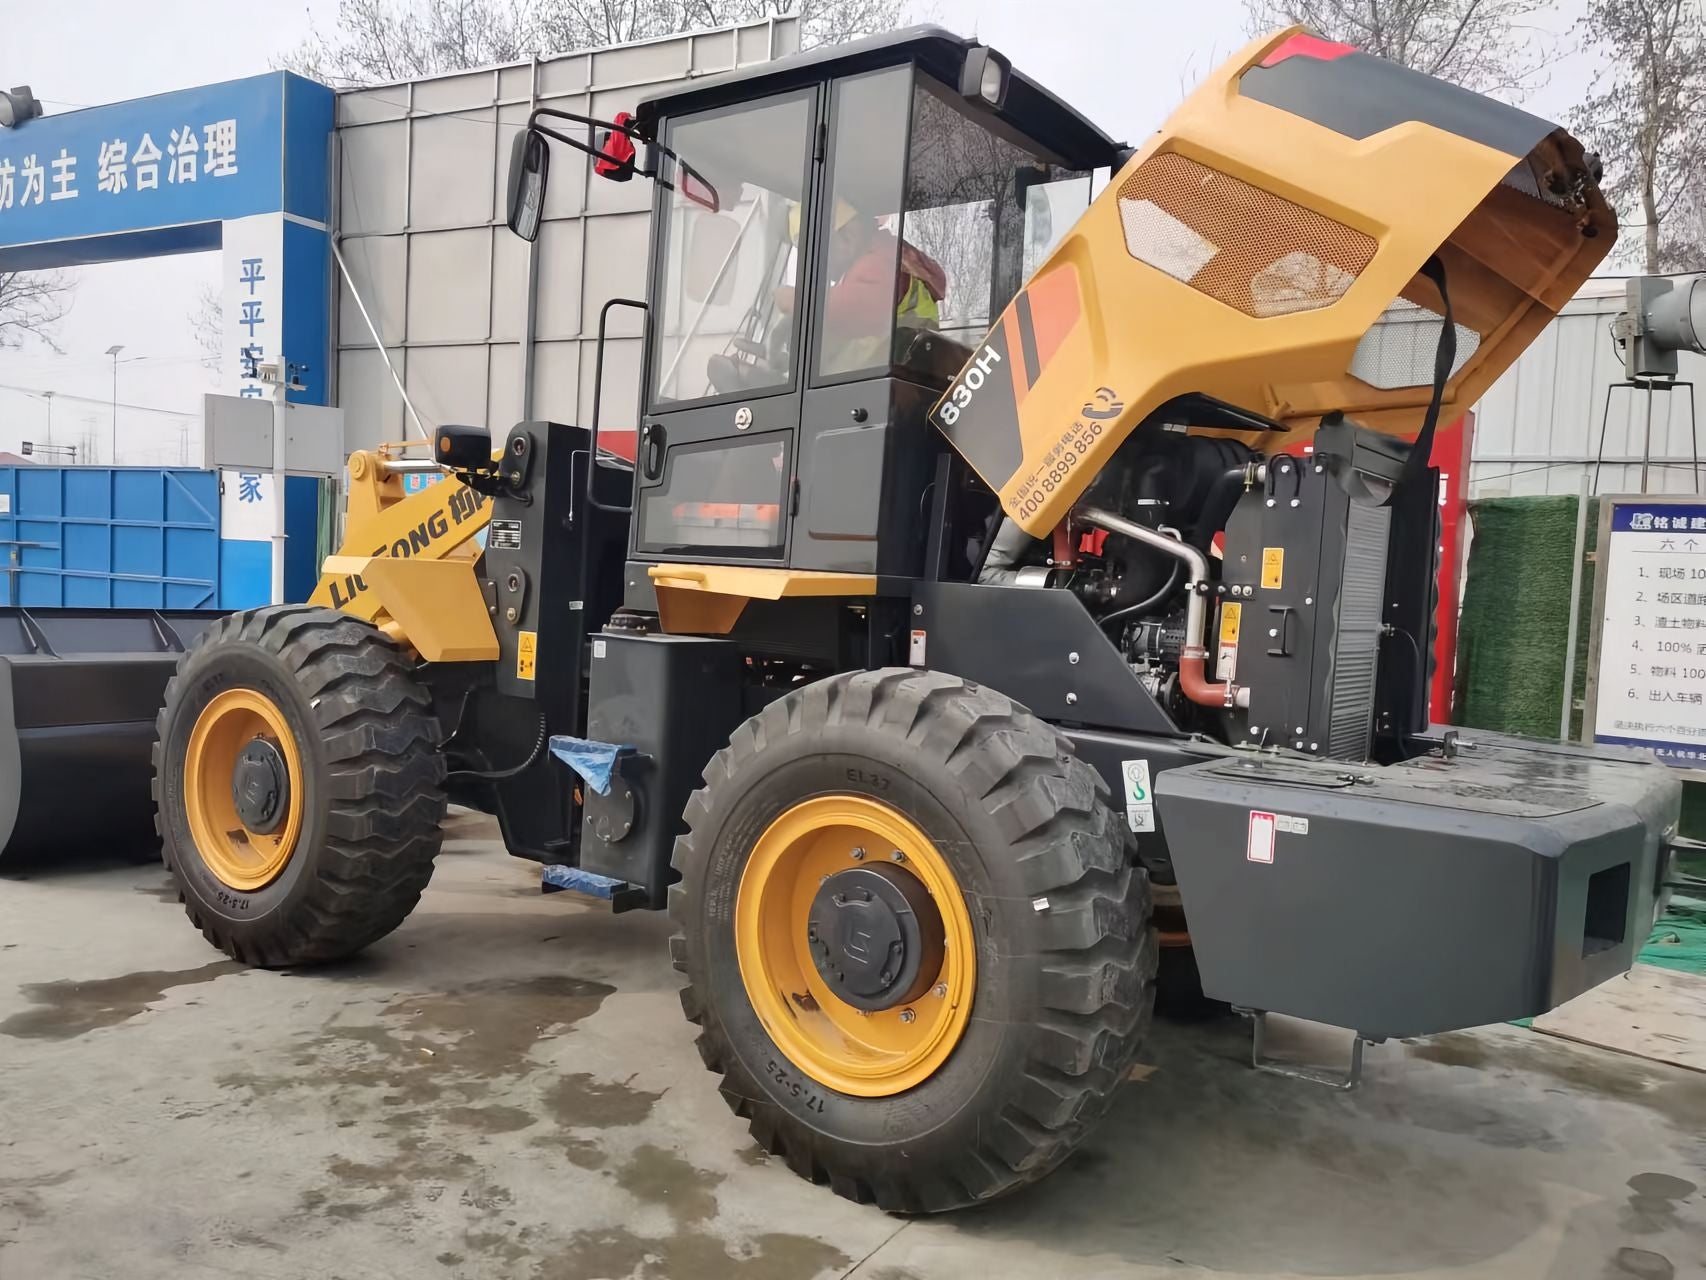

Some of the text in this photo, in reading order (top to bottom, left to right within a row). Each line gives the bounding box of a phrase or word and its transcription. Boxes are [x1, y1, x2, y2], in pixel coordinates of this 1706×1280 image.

[97, 118, 238, 194] 综合治理
[939, 344, 1001, 425] 830H
[765, 1059, 824, 1114] 17.5-25
